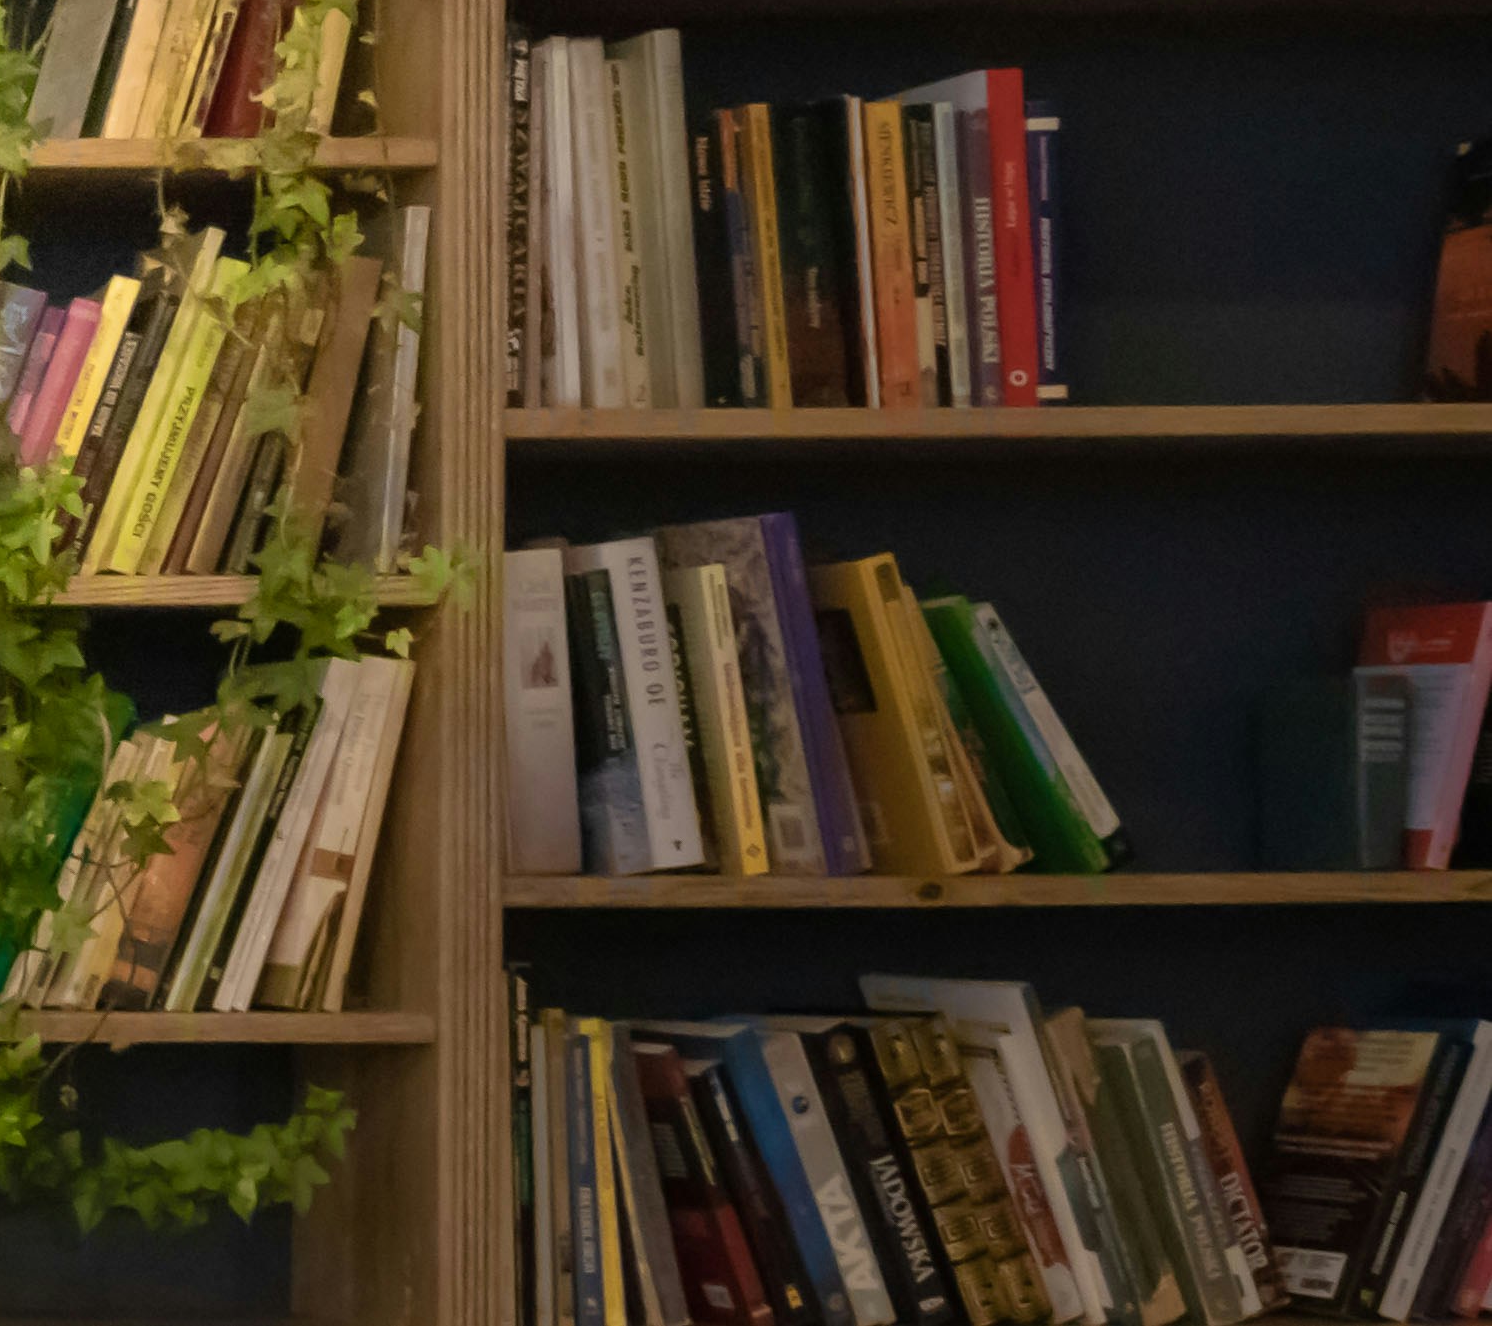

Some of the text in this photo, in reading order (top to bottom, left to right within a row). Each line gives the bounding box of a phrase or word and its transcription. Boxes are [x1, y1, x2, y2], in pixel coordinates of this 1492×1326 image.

[970, 195, 1003, 365] HISTORIA POLSKI
[128, 384, 199, 541] PRZYJMUJEMY GOŚCI
[622, 554, 667, 707] KENZABURO OE
[867, 1151, 940, 1284] JADOWSKA
[1155, 1119, 1201, 1213] HISTORIA
